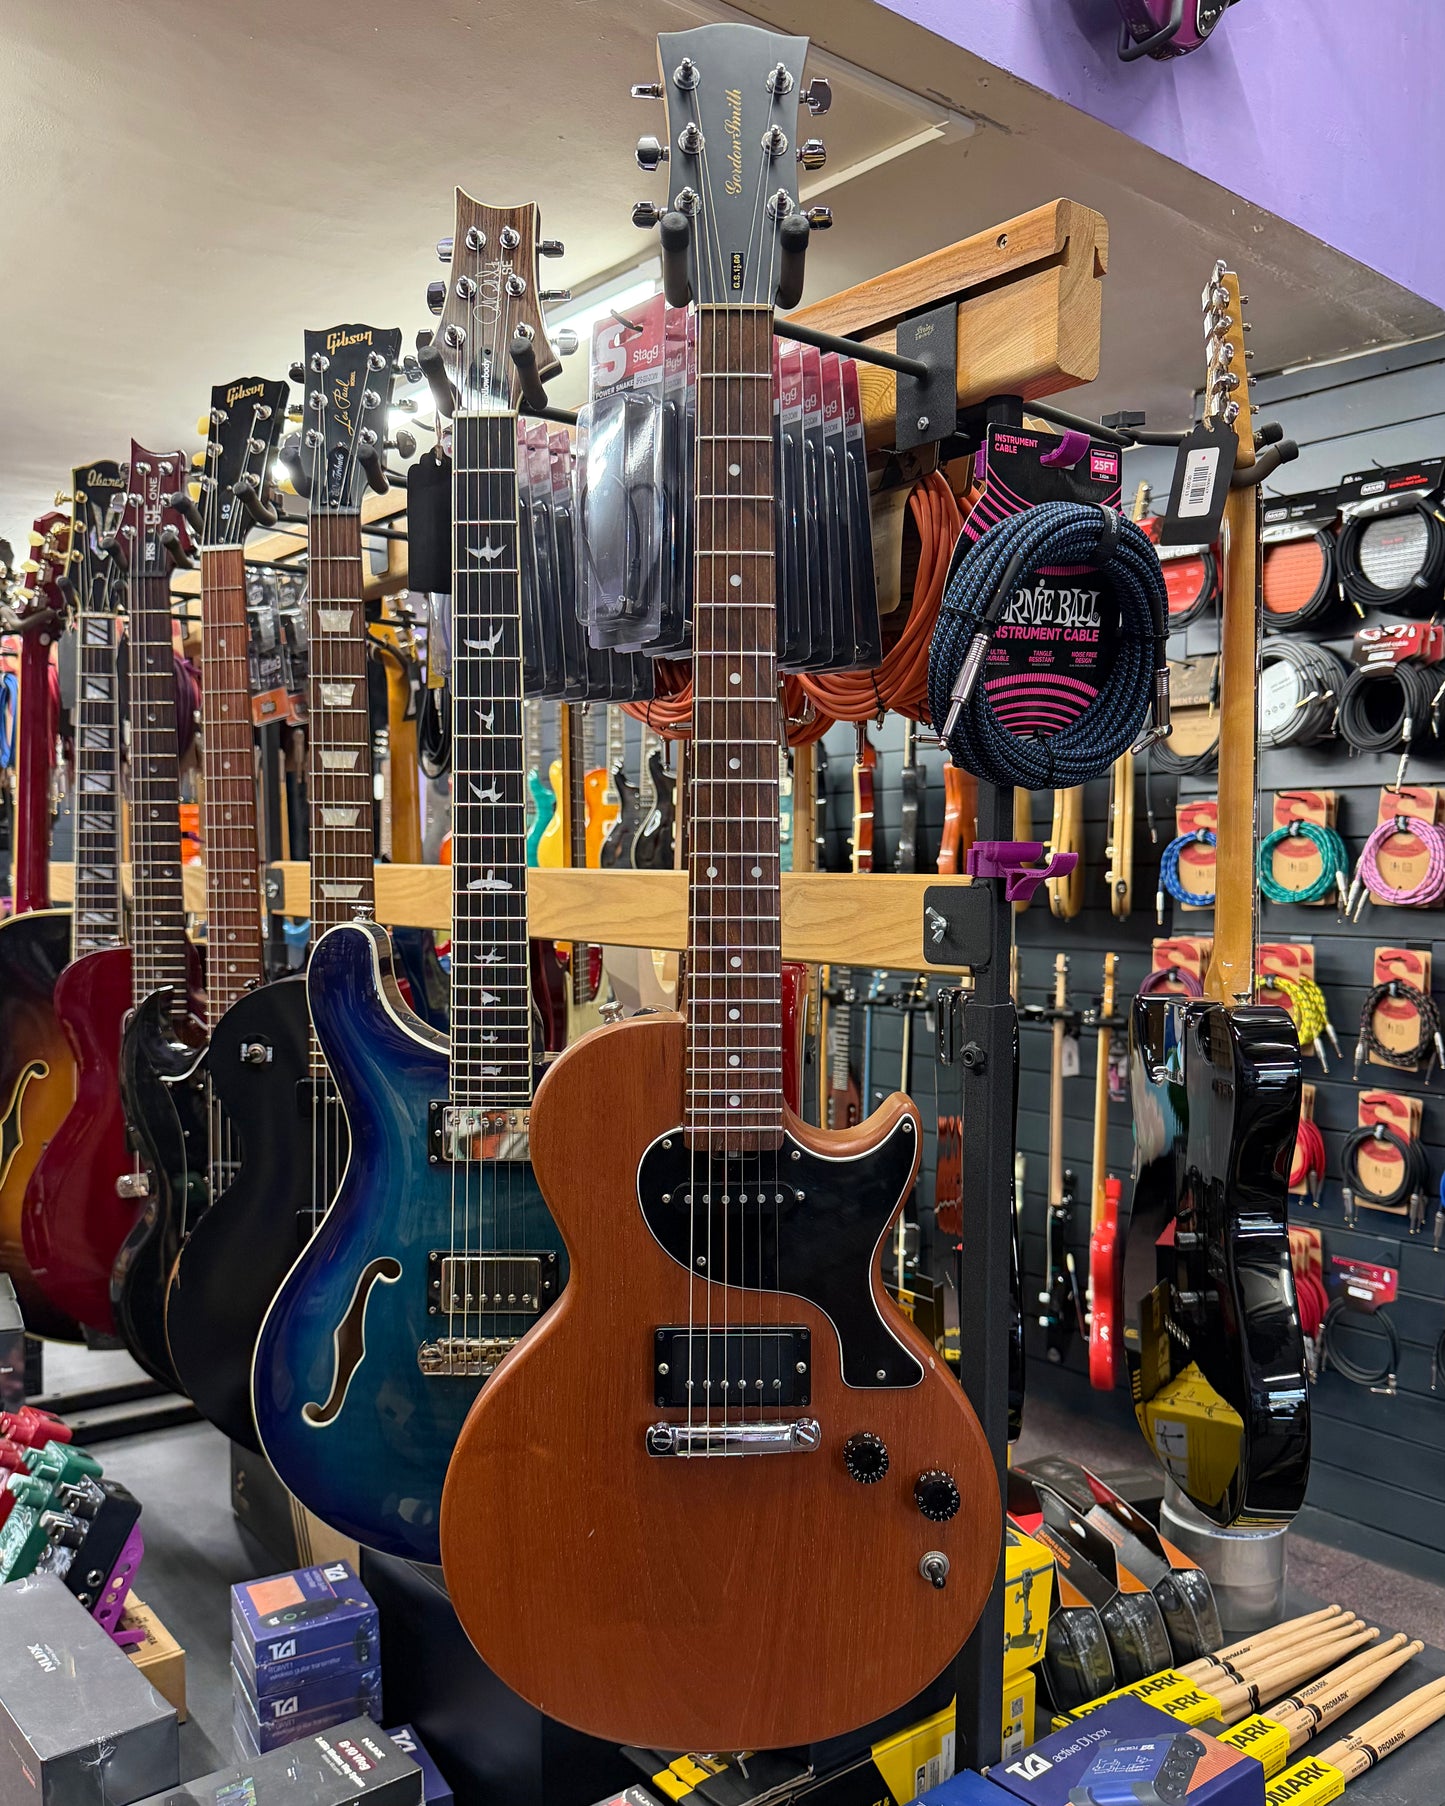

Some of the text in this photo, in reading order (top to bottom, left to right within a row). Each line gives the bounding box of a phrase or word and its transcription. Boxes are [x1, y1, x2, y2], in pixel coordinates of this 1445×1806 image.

[502, 259, 513, 275] SE
[326, 330, 373, 356] Gibson
[633, 344, 659, 364] Stagg
[665, 353, 682, 371] agg
[226, 383, 265, 408] Gibson
[595, 387, 615, 400] POWER
[616, 379, 634, 392] SNAKE
[333, 378, 355, 437] Les Paul
[994, 433, 1039, 448] INSTRUMENT
[994, 442, 1018, 454] CABLE
[1094, 460, 1114, 472] 25FT
[149, 476, 158, 501] ONE
[144, 504, 162, 525] SE
[221, 504, 231, 520] SG
[146, 542, 156, 562] PRS
[1001, 578, 1101, 628] RNIE BALL
[993, 625, 1100, 642] NSTRUMENT CABLE
[27, 1643, 57, 1673] NUX
[268, 1639, 297, 1661] TGI
[1222, 1645, 1251, 1663] PROMARK
[1300, 1680, 1328, 1700] PROMARK
[271, 1696, 299, 1717] TGI
[1322, 1691, 1350, 1713] PROMARK
[1224, 1718, 1277, 1750] MARK
[1378, 1730, 1406, 1754] PROMARK
[338, 1740, 358, 1758] B-10
[352, 1752, 372, 1771] Vlog
[361, 1737, 386, 1760] NUX
[1052, 1742, 1081, 1764] active
[1078, 1736, 1093, 1749] DI
[1089, 1726, 1112, 1743] box
[1005, 1752, 1054, 1782] TGI
